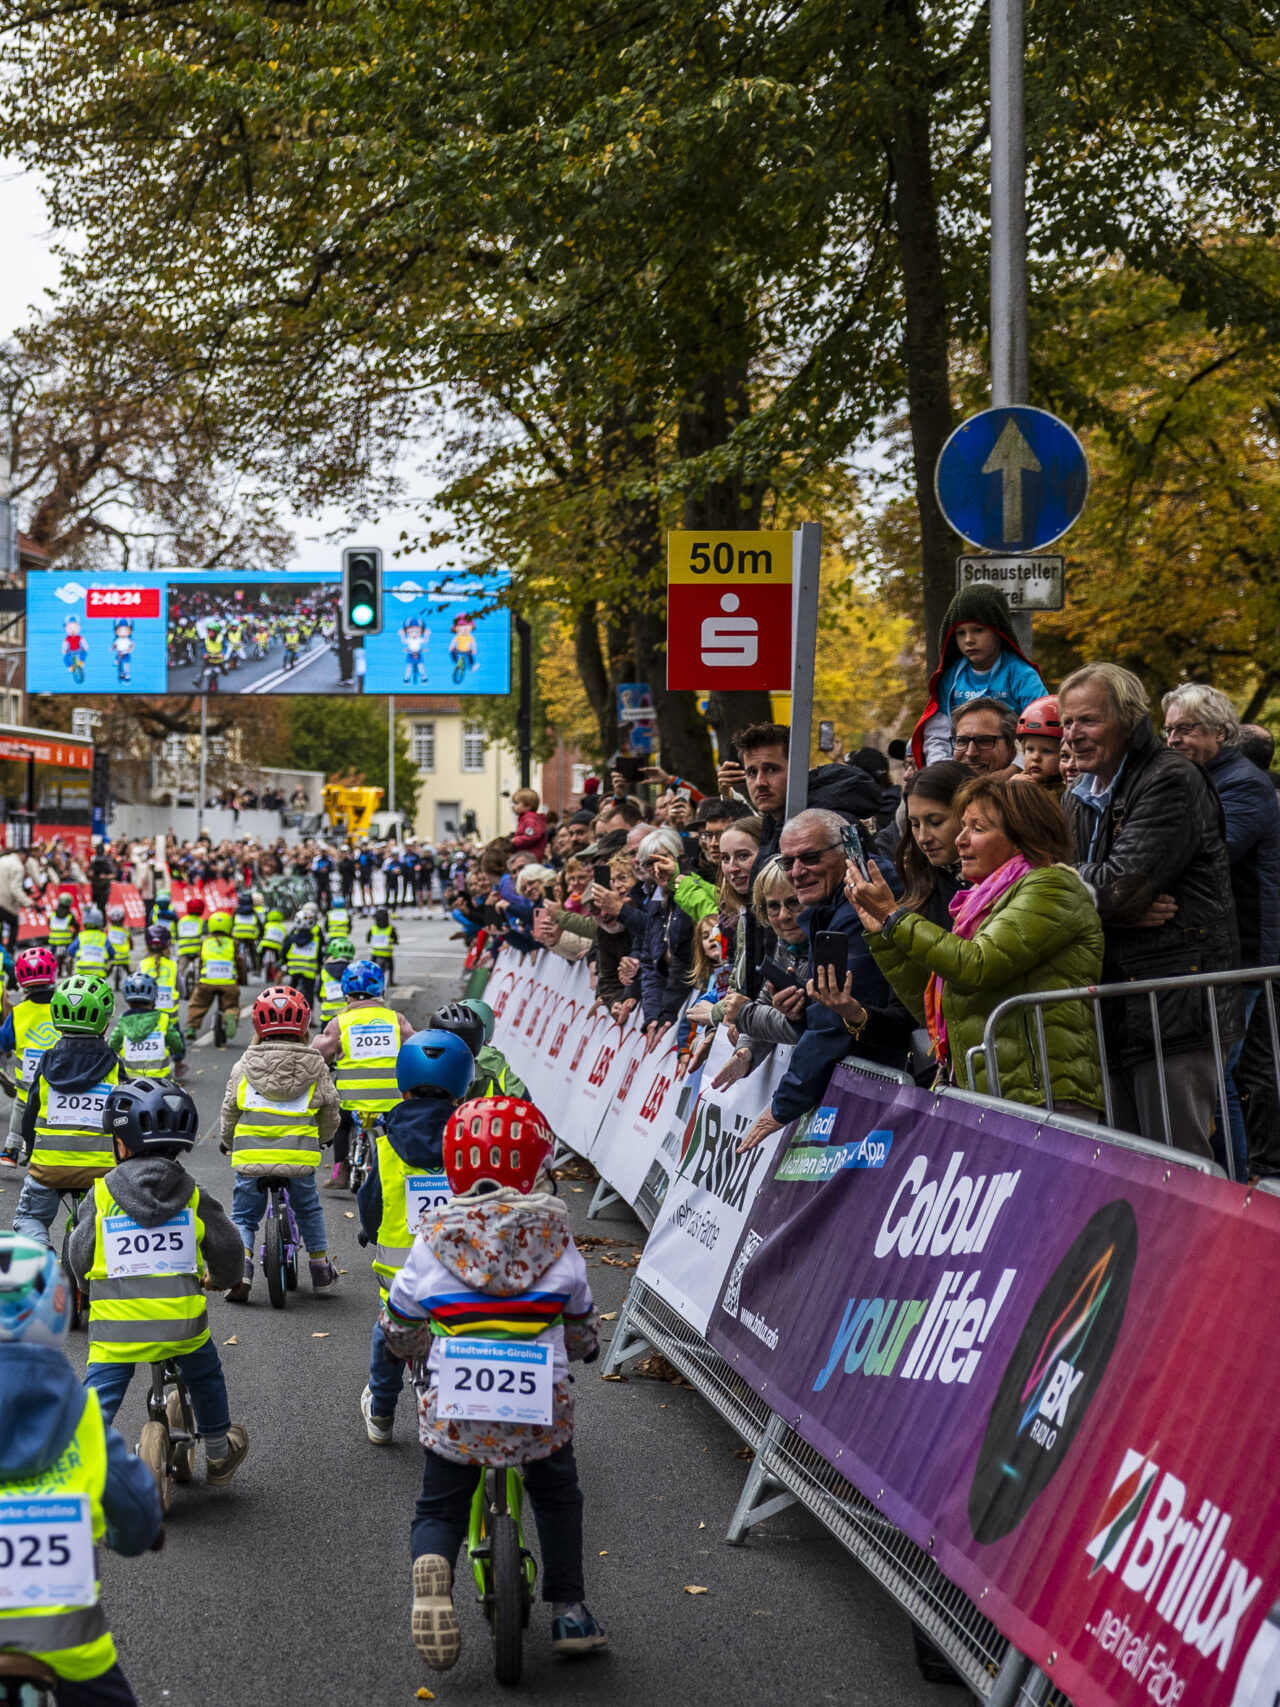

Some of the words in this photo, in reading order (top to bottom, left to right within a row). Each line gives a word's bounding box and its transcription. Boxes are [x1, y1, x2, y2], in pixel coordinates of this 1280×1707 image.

[689, 541, 773, 575] 50m
[963, 562, 1059, 581] Schausteller
[130, 1041, 159, 1052] 2025
[355, 1035, 391, 1048] 2025
[587, 1044, 616, 1088] LBS
[56, 1095, 105, 1112] 2025
[639, 1072, 672, 1123] LBS
[873, 1151, 1022, 1259] Colour
[116, 1231, 185, 1256] 2025
[812, 1298, 929, 1392] your
[900, 1268, 1018, 1384] life!
[449, 1344, 544, 1361] Stadtwerke-Girolino
[453, 1366, 538, 1396] 2025
[1038, 1359, 1085, 1428] BX
[1029, 1418, 1058, 1451] RADIO
[1120, 1471, 1264, 1673] Brillux
